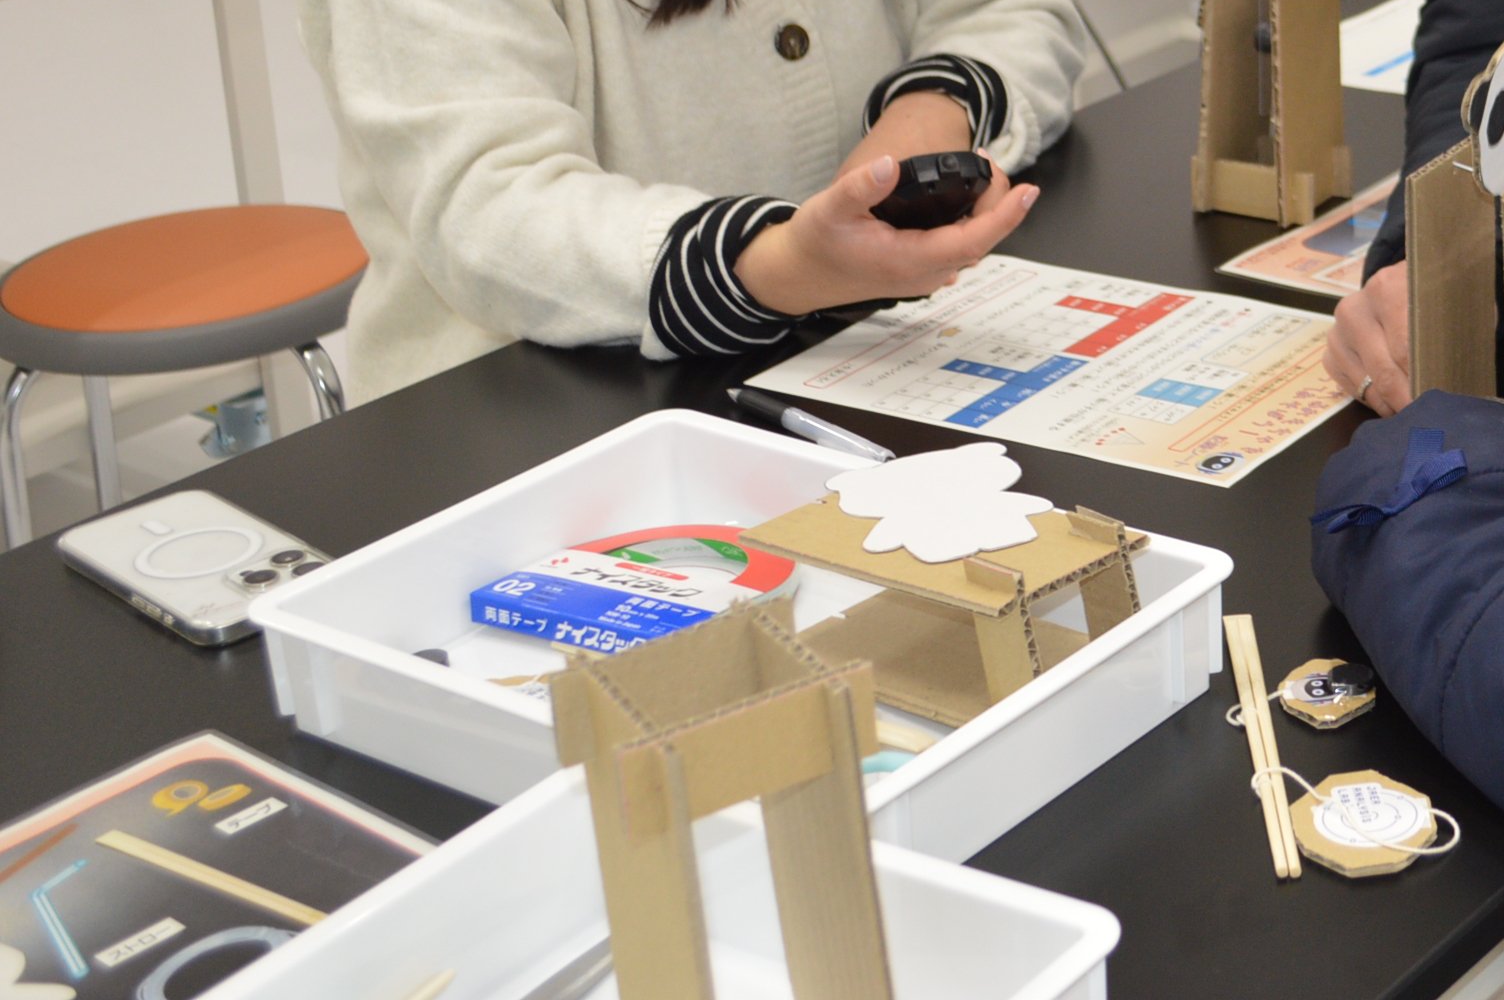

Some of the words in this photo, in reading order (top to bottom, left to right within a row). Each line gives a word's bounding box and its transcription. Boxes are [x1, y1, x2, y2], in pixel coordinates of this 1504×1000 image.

[493, 579, 537, 596] 02
[570, 567, 703, 598] ナイスタック
[485, 605, 548, 632] 両面テープ
[625, 596, 701, 617] 両面テープ
[228, 803, 273, 828] テープ
[109, 925, 172, 962] ストロー
